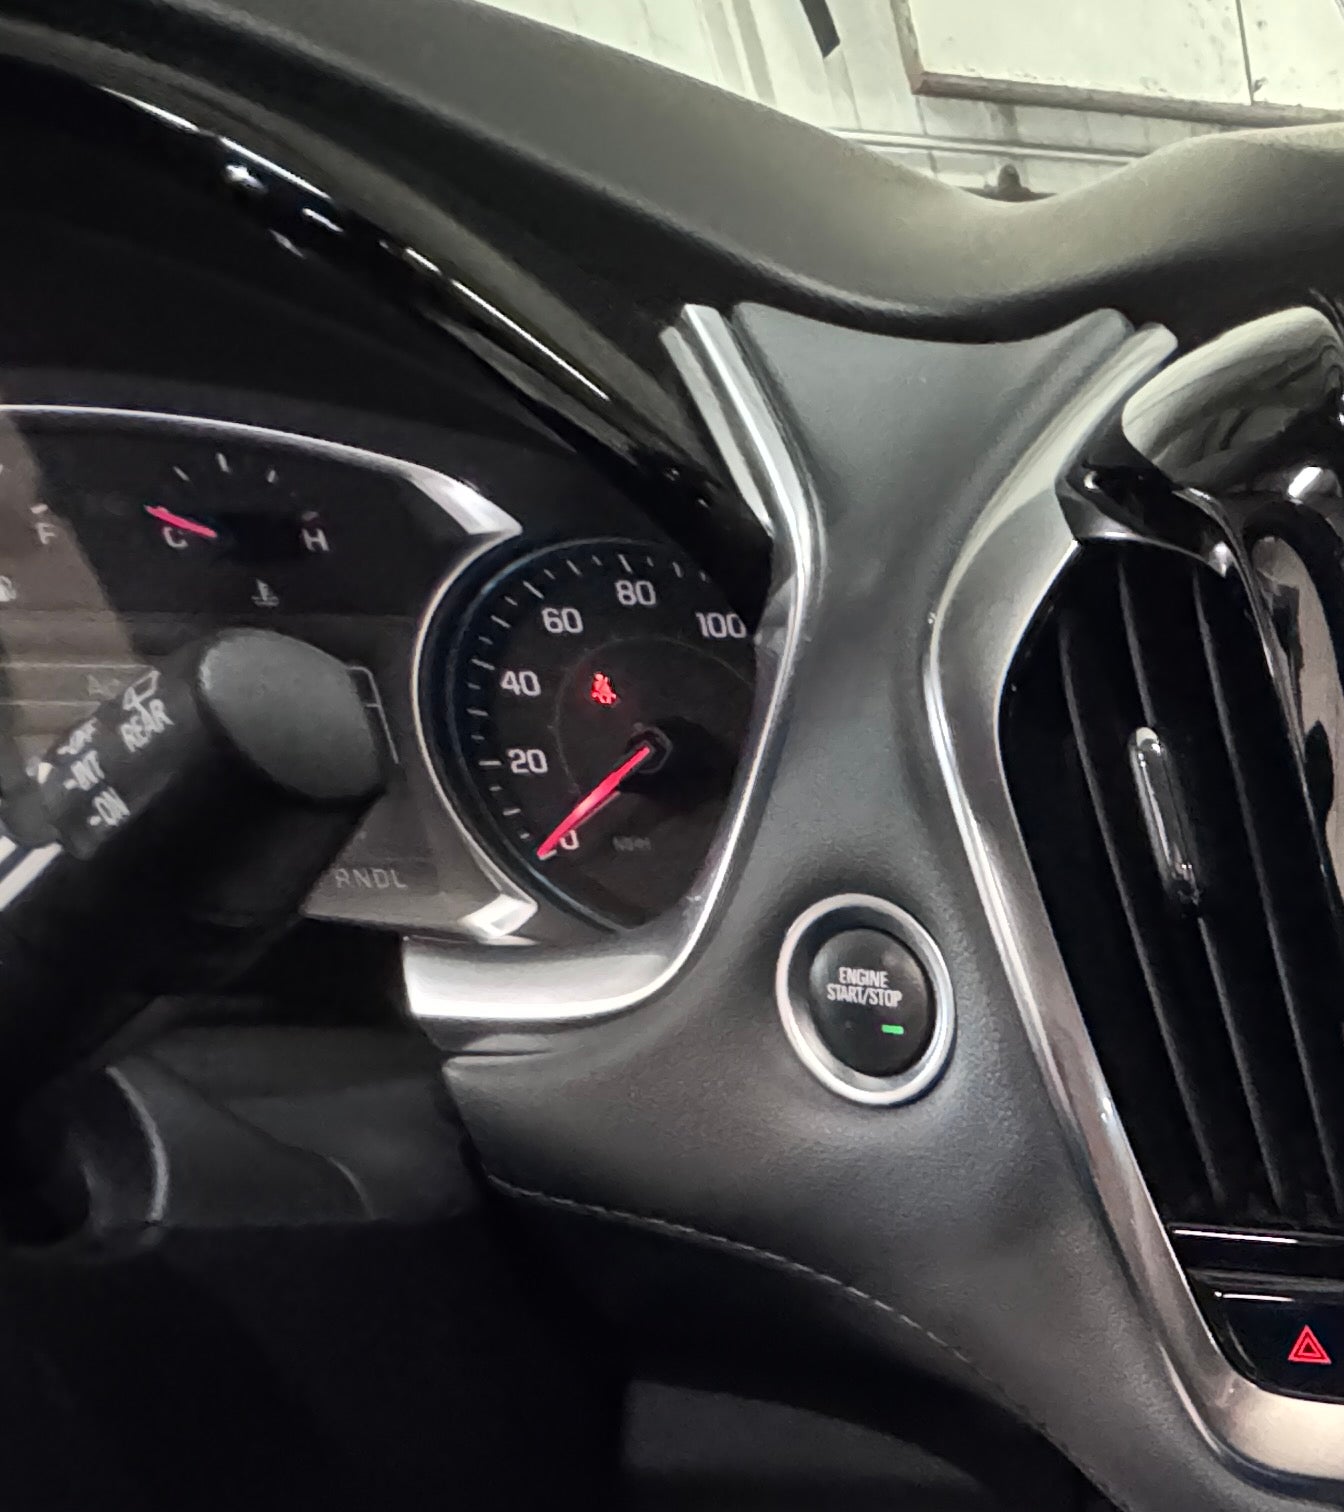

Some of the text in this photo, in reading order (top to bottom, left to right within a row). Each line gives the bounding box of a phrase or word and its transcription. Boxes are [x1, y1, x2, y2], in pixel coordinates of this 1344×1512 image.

[35, 521, 56, 545] F
[302, 528, 330, 551] H
[614, 579, 657, 606] 80
[541, 607, 584, 634] 60
[695, 612, 747, 639] 100
[500, 670, 542, 697] 40
[507, 748, 548, 774] 20
[838, 966, 889, 988] ENGINE
[826, 983, 903, 1008] START/STOP
